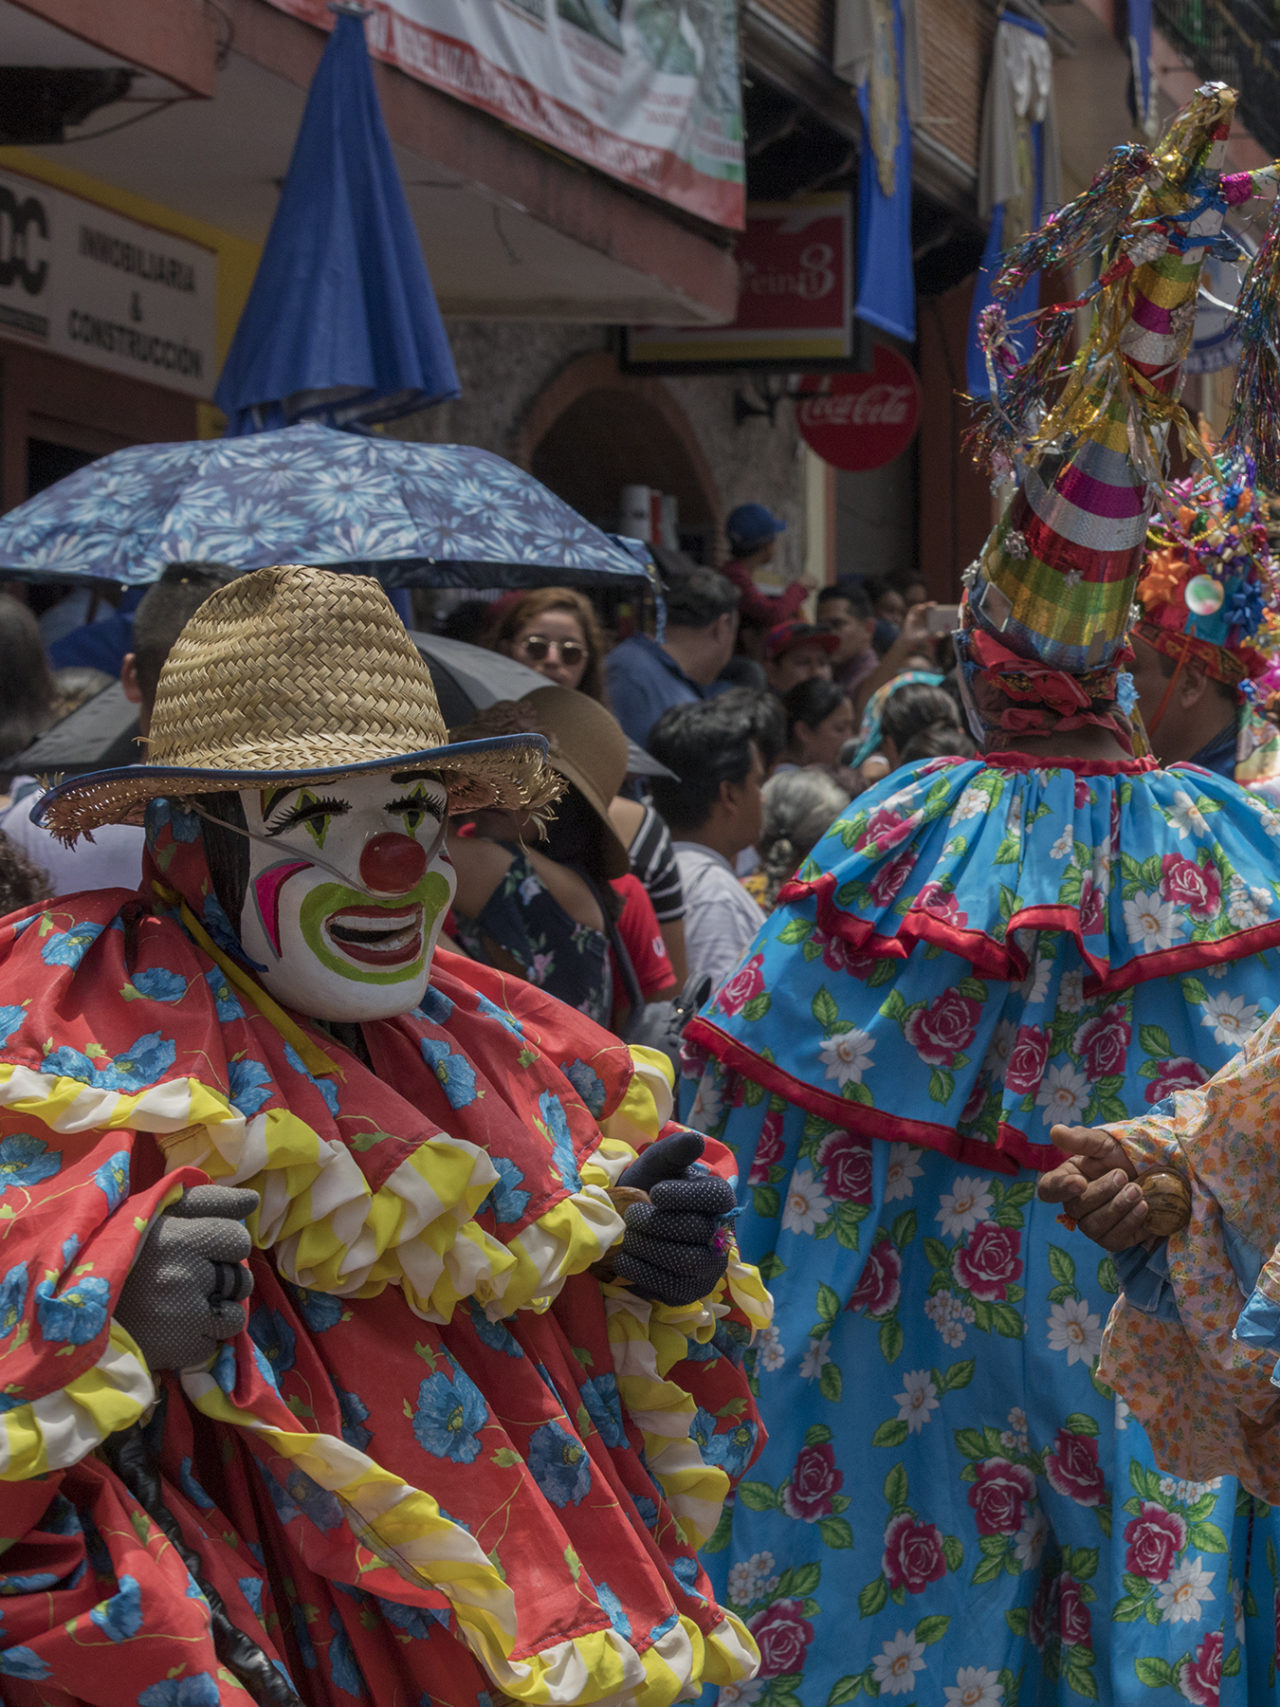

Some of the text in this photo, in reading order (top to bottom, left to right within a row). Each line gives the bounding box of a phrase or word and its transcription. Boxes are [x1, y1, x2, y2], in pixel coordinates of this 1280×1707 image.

[79, 224, 197, 294] INMOBILIARIA
[129, 290, 144, 323] &
[68, 308, 204, 379] CONSTRUCCIÓN
